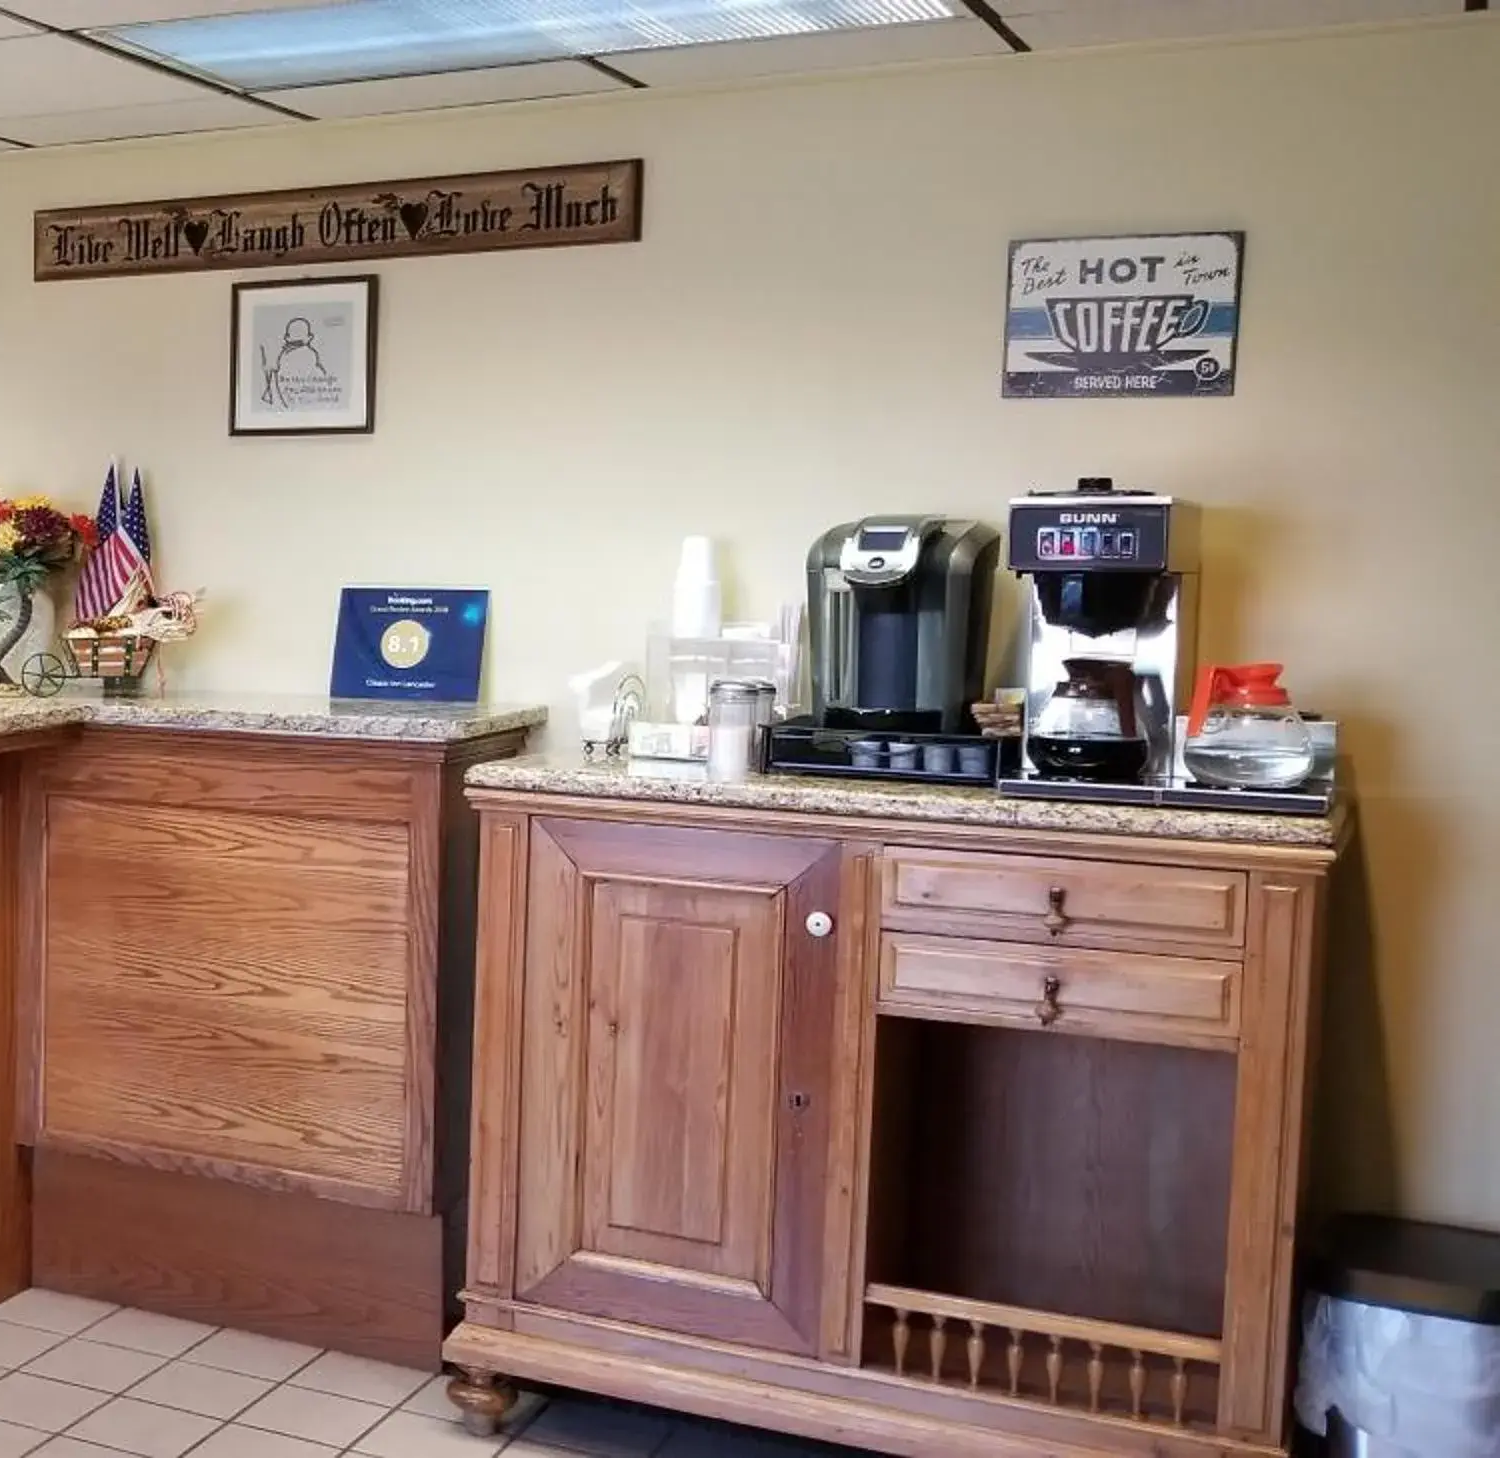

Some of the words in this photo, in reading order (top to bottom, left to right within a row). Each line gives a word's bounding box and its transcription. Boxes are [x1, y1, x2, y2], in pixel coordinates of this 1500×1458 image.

[47, 224, 114, 266] Live
[117, 216, 181, 261] Well
[209, 208, 305, 258] Laugh
[318, 201, 397, 248] Often
[427, 189, 513, 238] Love
[519, 180, 618, 233] Much
[1021, 254, 1051, 274] The
[1173, 251, 1200, 269] in
[1079, 256, 1165, 285] HOT
[1183, 266, 1230, 286] Town
[1021, 268, 1069, 295] Best
[1055, 299, 1187, 352] COFFEE
[1074, 375, 1120, 389] SERVED
[1125, 374, 1157, 389] HERE
[1060, 513, 1118, 524] BUNN
[387, 634, 420, 654] 8.1
